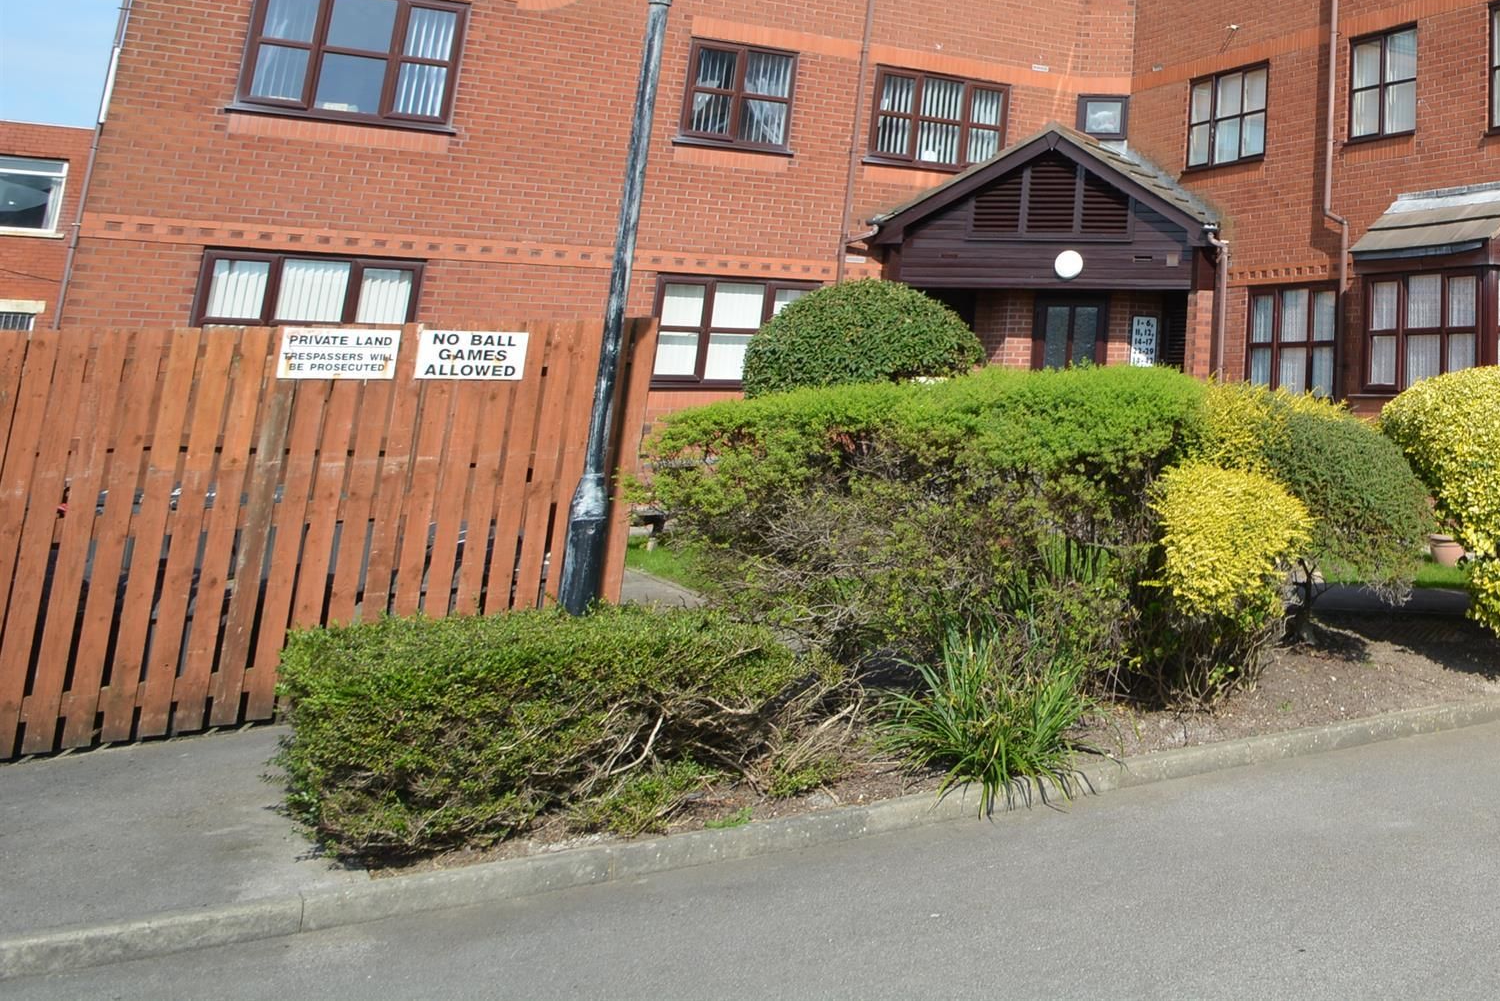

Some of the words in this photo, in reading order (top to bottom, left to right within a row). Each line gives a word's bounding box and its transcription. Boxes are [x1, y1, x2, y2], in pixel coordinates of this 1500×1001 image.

[289, 335, 348, 345] PRIVATE
[356, 336, 393, 346] LAND
[432, 333, 459, 345] NO
[470, 334, 516, 346] BALL
[283, 352, 363, 361] TRESPASSERS
[370, 353, 394, 361] WILL
[439, 349, 507, 361] GAMES
[289, 363, 304, 371] BE
[310, 363, 385, 372] PROSECUTED
[424, 364, 516, 376] ALLOWED
